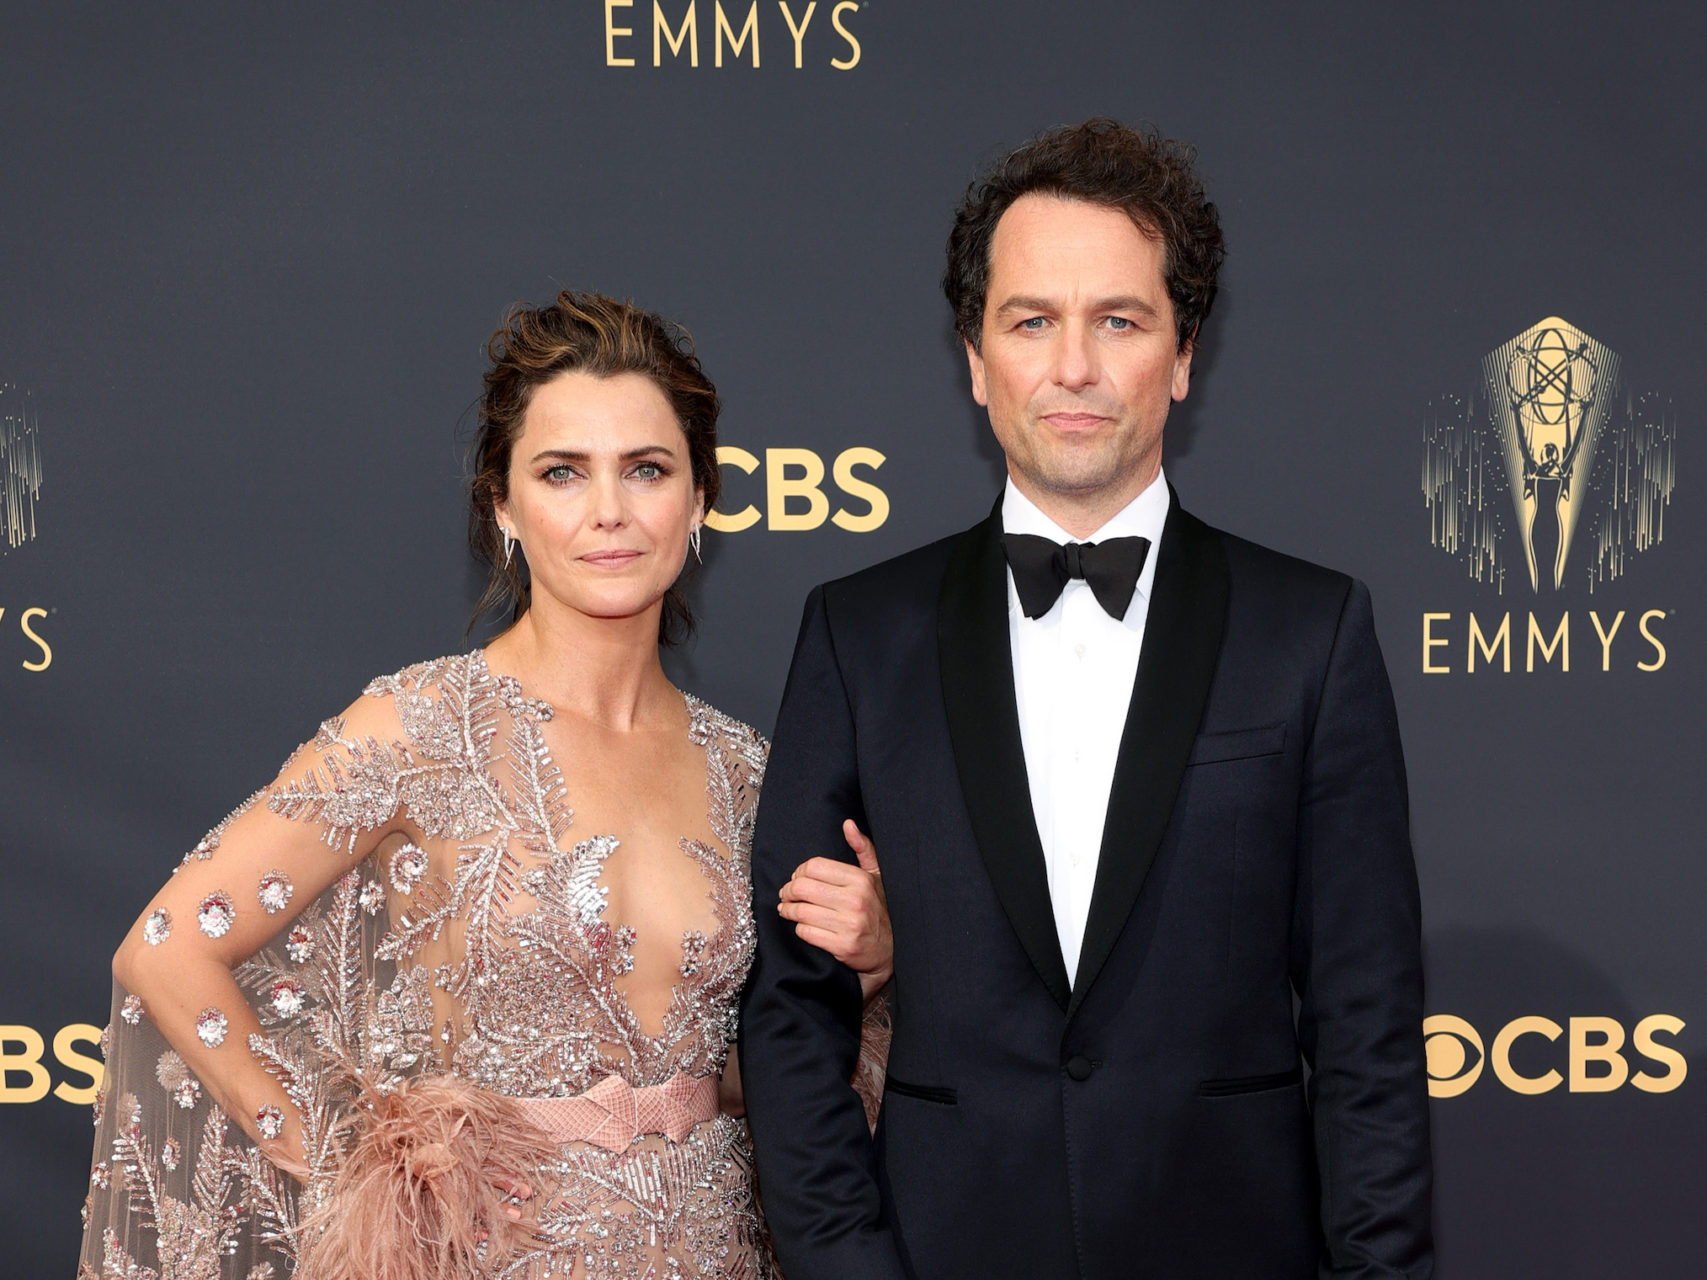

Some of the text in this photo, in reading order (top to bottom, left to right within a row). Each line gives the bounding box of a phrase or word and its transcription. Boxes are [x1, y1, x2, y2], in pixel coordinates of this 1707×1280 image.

[605, 0, 861, 70] EMMYS
[703, 446, 890, 533] CBS
[0, 607, 52, 672] S
[1422, 609, 1667, 674] EMMYS
[0, 1023, 105, 1105] BS
[1491, 1013, 1688, 1096] CBS
